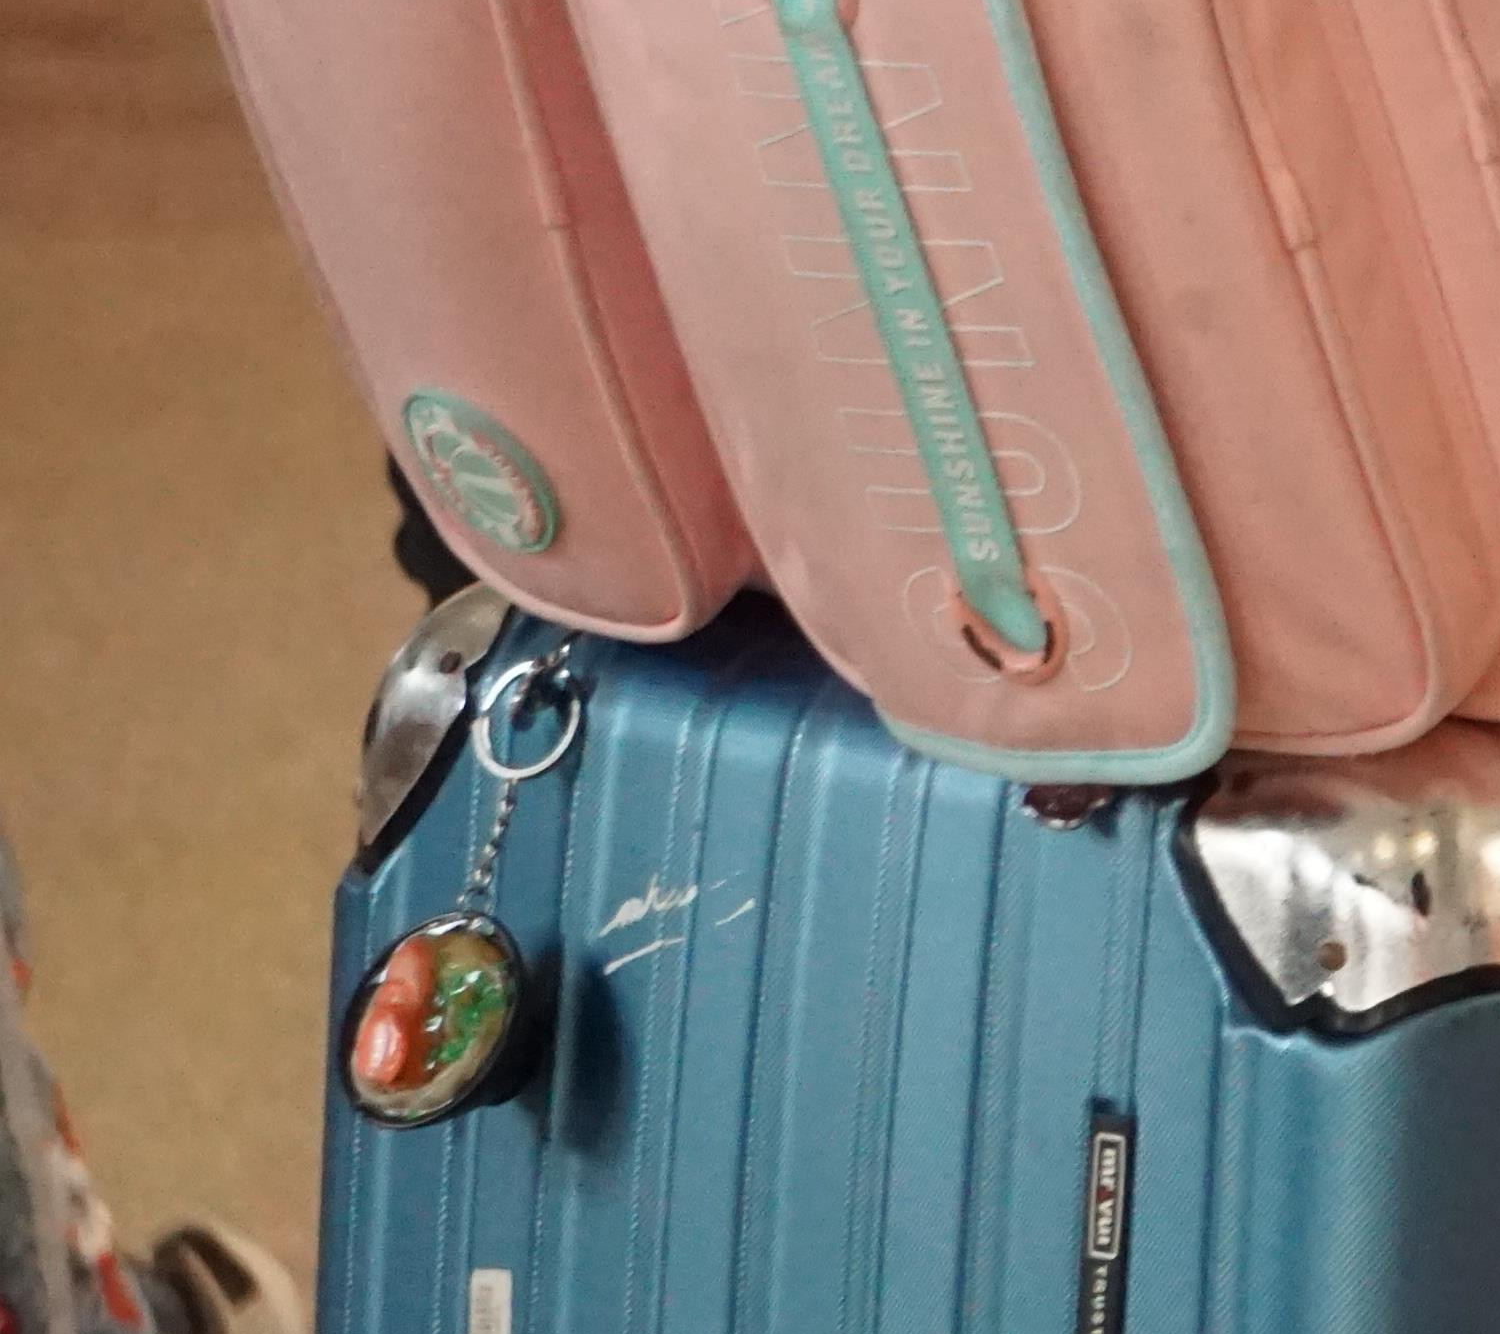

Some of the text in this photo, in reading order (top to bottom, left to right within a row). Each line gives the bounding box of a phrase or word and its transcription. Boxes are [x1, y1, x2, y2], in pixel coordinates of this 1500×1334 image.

[855, 185, 912, 299] YOUR
[899, 309, 933, 347] IN
[920, 357, 1001, 562] SUNSHINE
